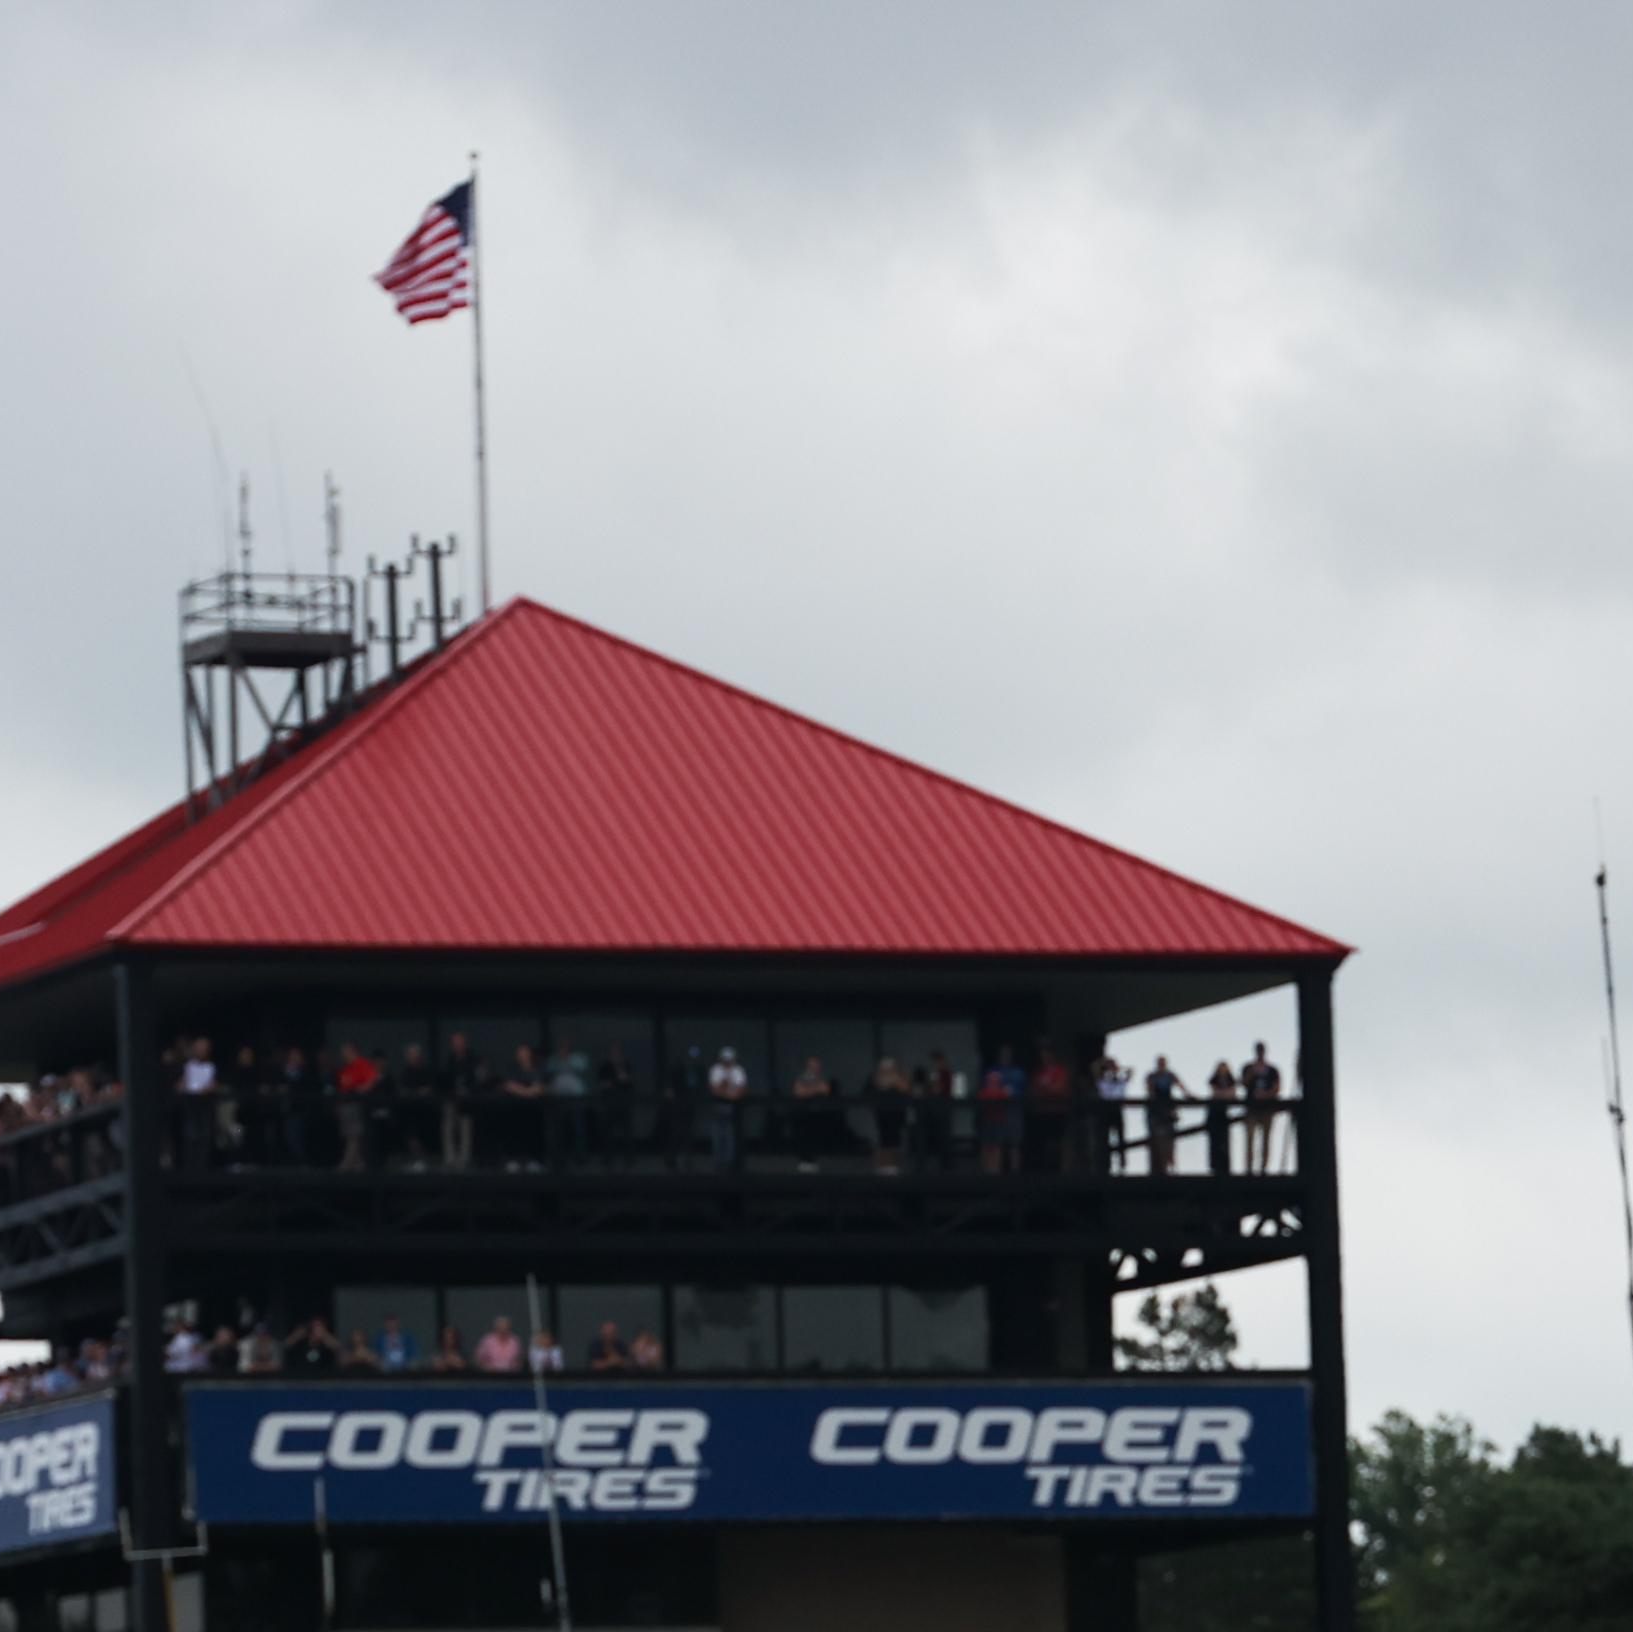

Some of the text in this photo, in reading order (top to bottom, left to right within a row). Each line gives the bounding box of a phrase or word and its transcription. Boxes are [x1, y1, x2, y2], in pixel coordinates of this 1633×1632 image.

[250, 1409, 710, 1470] COOPER
[810, 1406, 1252, 1464] COOPER
[25, 1481, 97, 1535] TIRES
[474, 1468, 699, 1512] TIRES
[1025, 1465, 1241, 1507] TIRES
